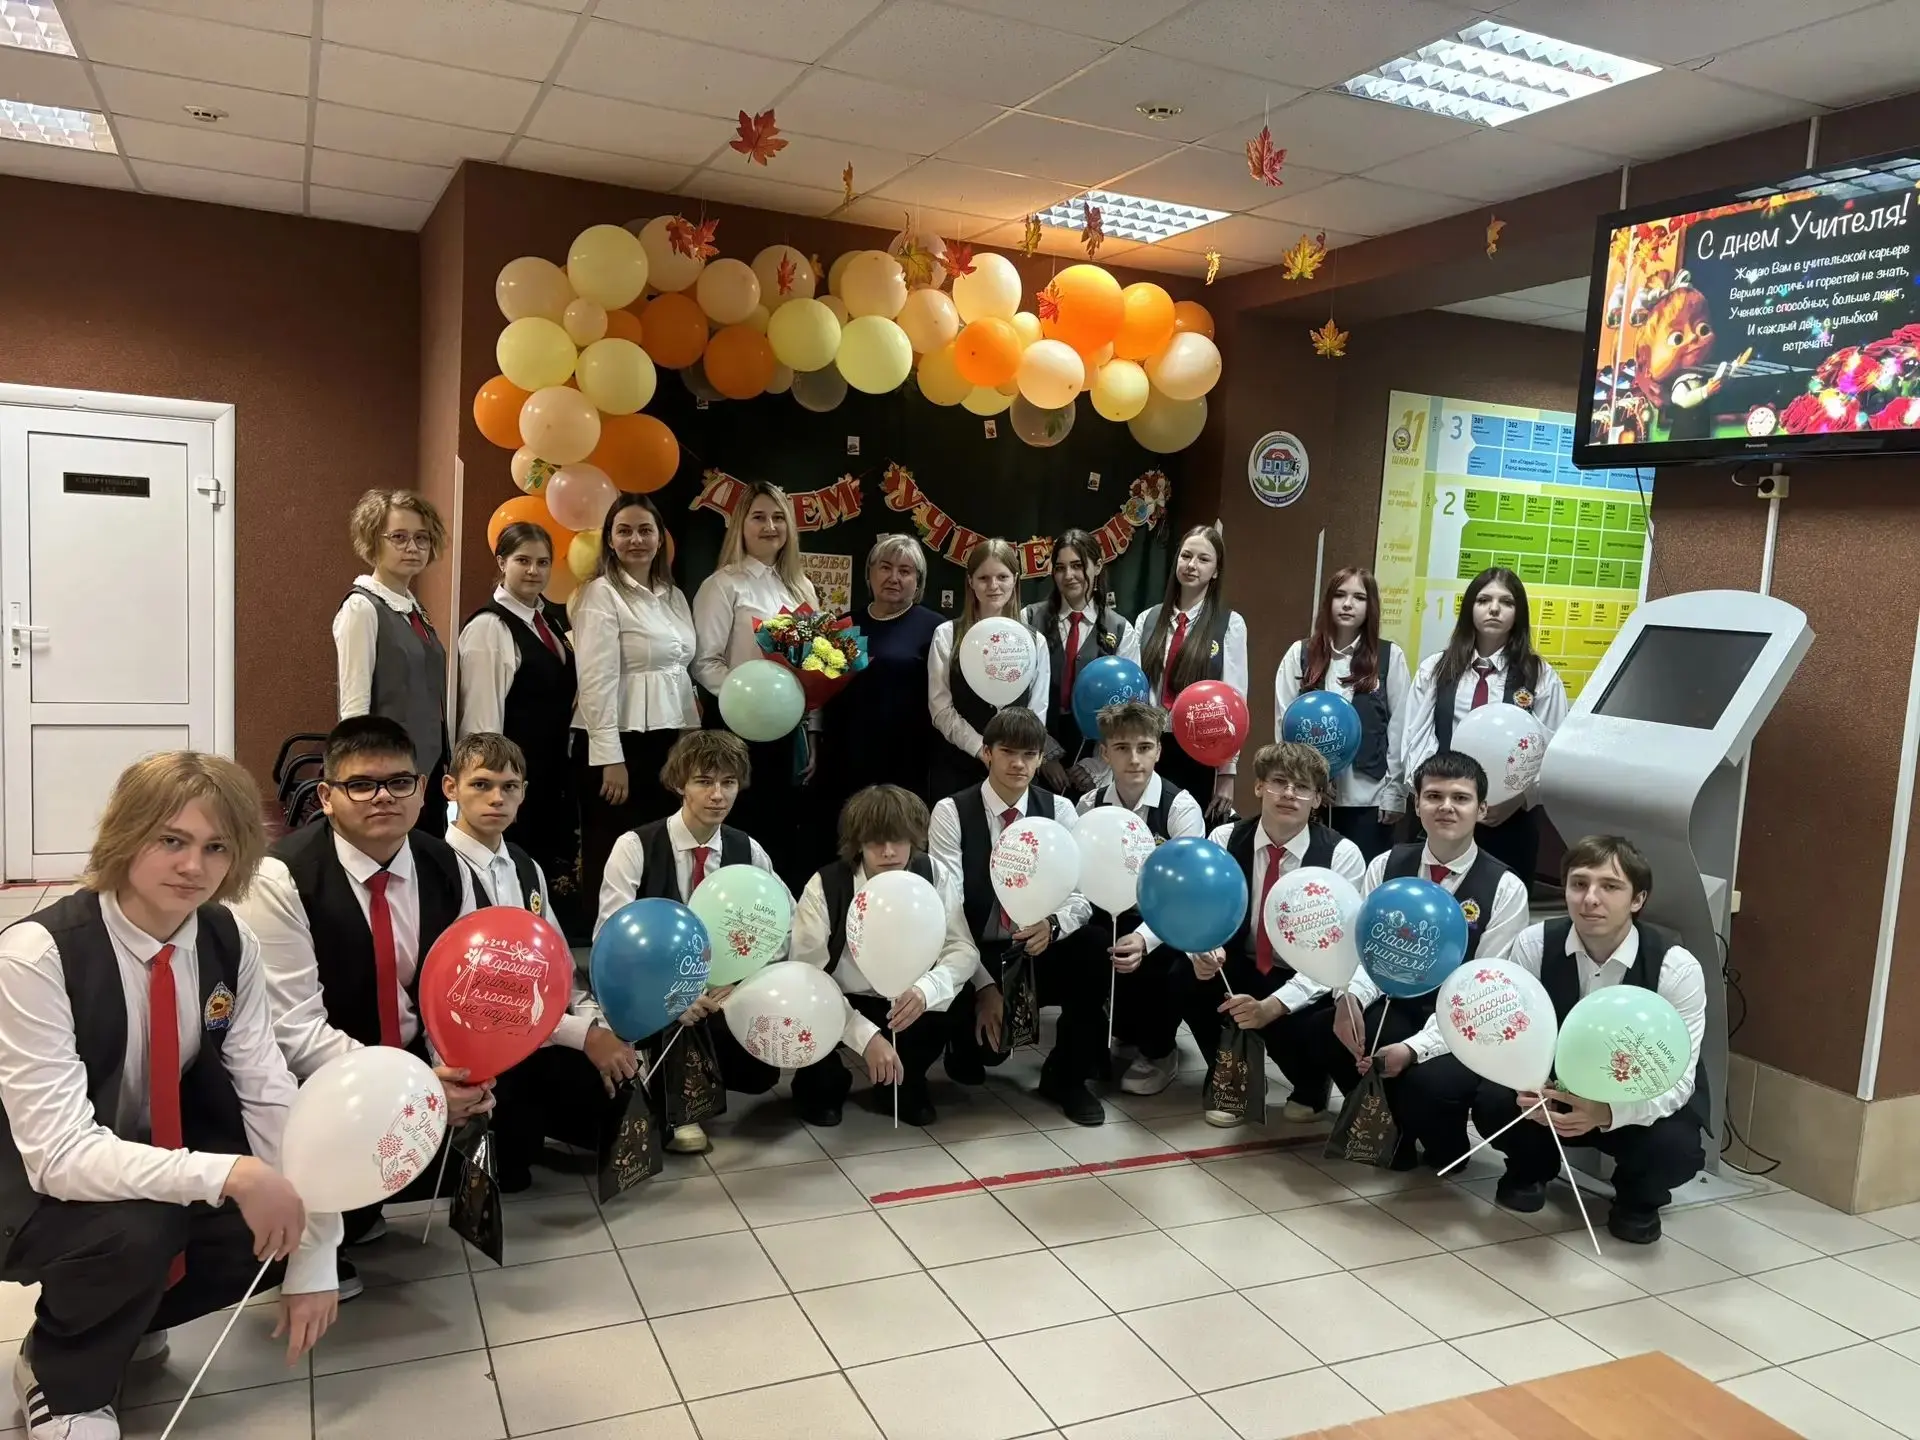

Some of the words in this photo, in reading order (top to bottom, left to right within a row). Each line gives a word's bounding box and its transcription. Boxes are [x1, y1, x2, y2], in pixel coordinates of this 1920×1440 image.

[1697, 230, 1714, 260] С
[1719, 227, 1780, 260] днем
[1785, 192, 1911, 245] Учителя!
[1771, 261, 1792, 275] Вам
[1794, 262, 1800, 271] в
[1802, 248, 1866, 273] учительской
[1868, 244, 1910, 261] карьере
[1729, 285, 1765, 301] Вершин
[1766, 281, 1805, 297] достичь
[1807, 279, 1814, 289] и
[1815, 272, 1859, 290] горестей
[1861, 270, 1874, 281] не
[1875, 265, 1910, 280] знать,
[1728, 305, 1774, 320] Учеников
[1776, 296, 1830, 314] способных,
[1832, 291, 1871, 307] больше
[1872, 287, 1906, 303] денег,
[1747, 323, 1755, 336] И
[1757, 318, 1798, 336] каждый
[1798, 317, 1822, 332] день
[1832, 310, 1878, 331] улыбкой
[1782, 335, 1835, 354] встречать!
[1450, 415, 1463, 440] 3
[688, 472, 862, 532] ДЕМ
[1443, 491, 1456, 516] 2
[1437, 596, 1444, 620] 1
[480, 953, 543, 979] Хороший
[1363, 940, 1438, 971] учитель!
[471, 973, 529, 995] учитель
[470, 989, 532, 1013] плохому
[1465, 992, 1518, 1022] классная
[462, 1003, 478, 1014] не
[481, 1007, 530, 1026] научит
[1473, 1002, 1519, 1029] классная
[1656, 1040, 1677, 1065] ШАРИК
